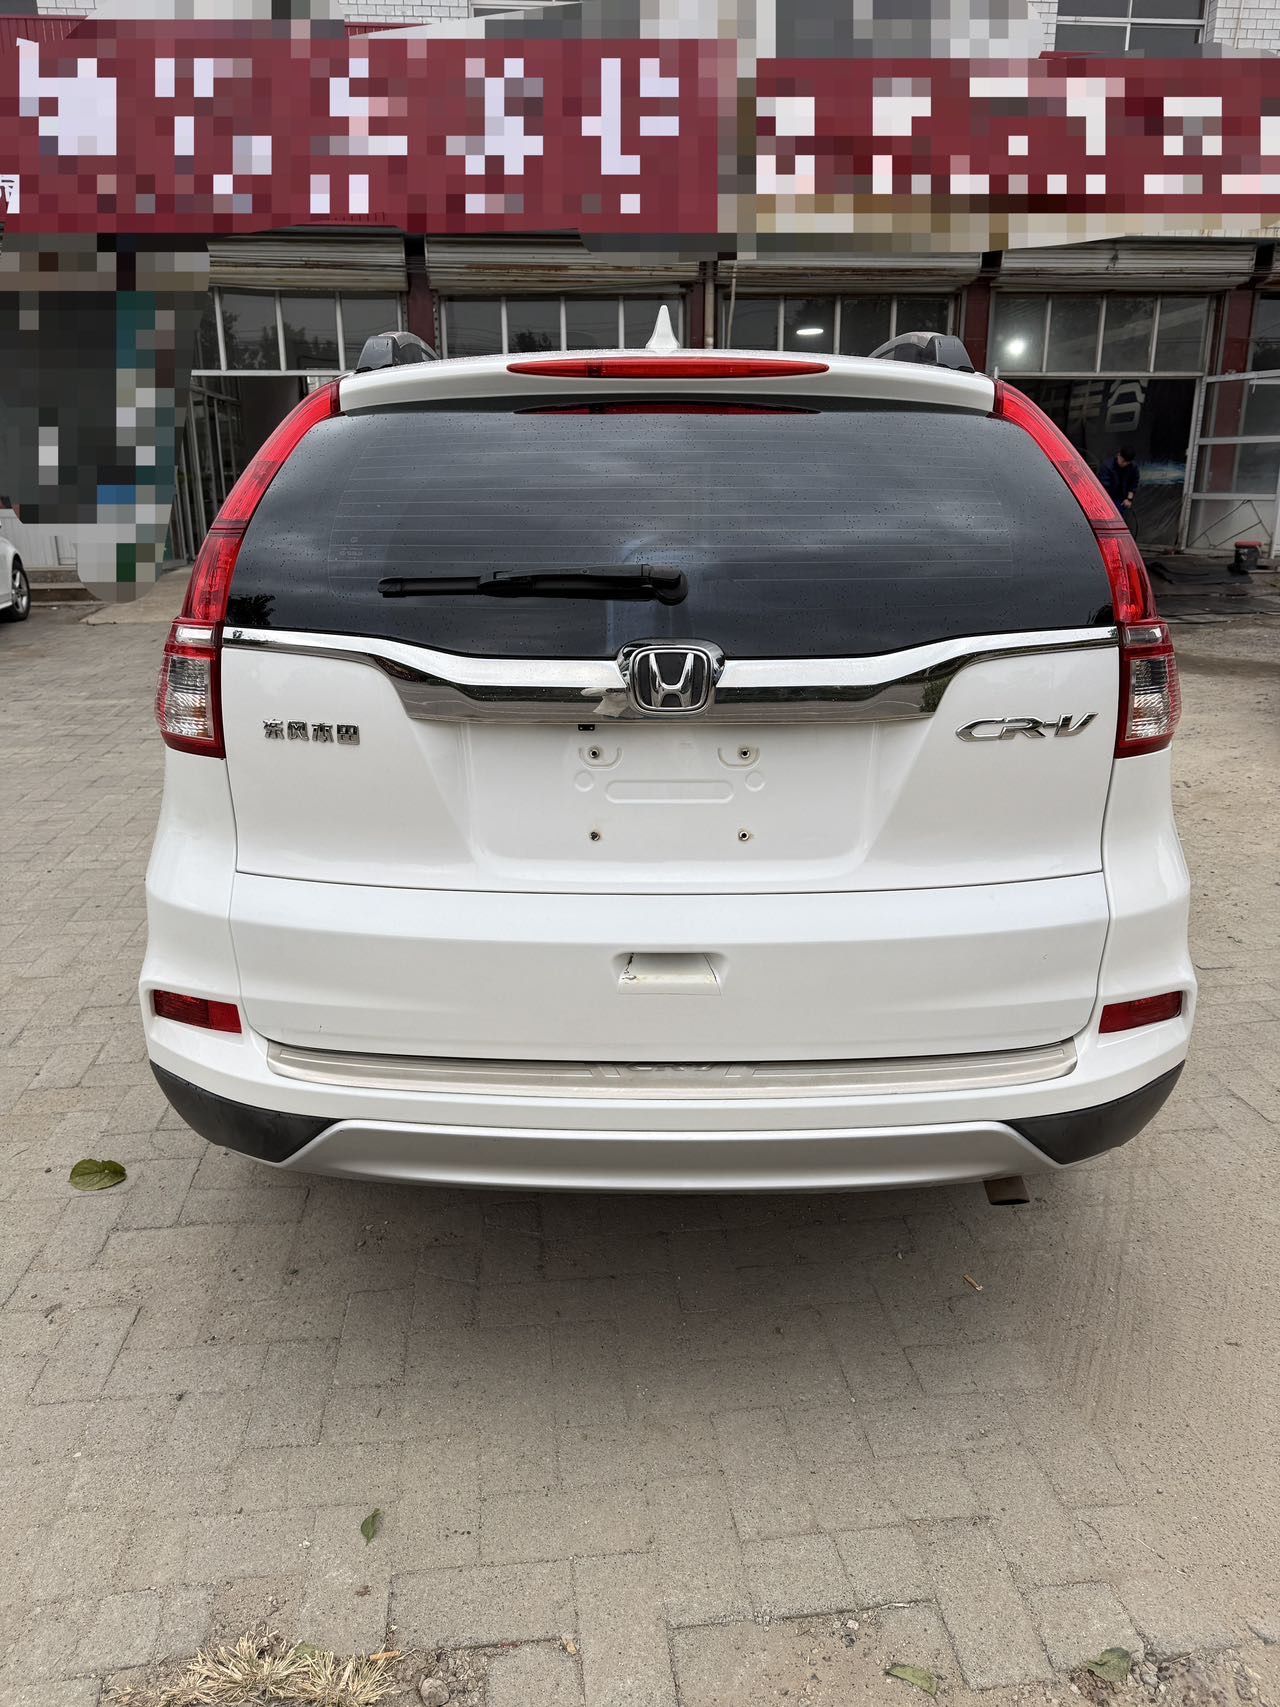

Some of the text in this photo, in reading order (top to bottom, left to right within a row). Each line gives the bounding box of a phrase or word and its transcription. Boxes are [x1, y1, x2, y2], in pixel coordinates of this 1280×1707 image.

[263, 719, 360, 745] 东风本田
[956, 712, 1099, 742] CR-V
